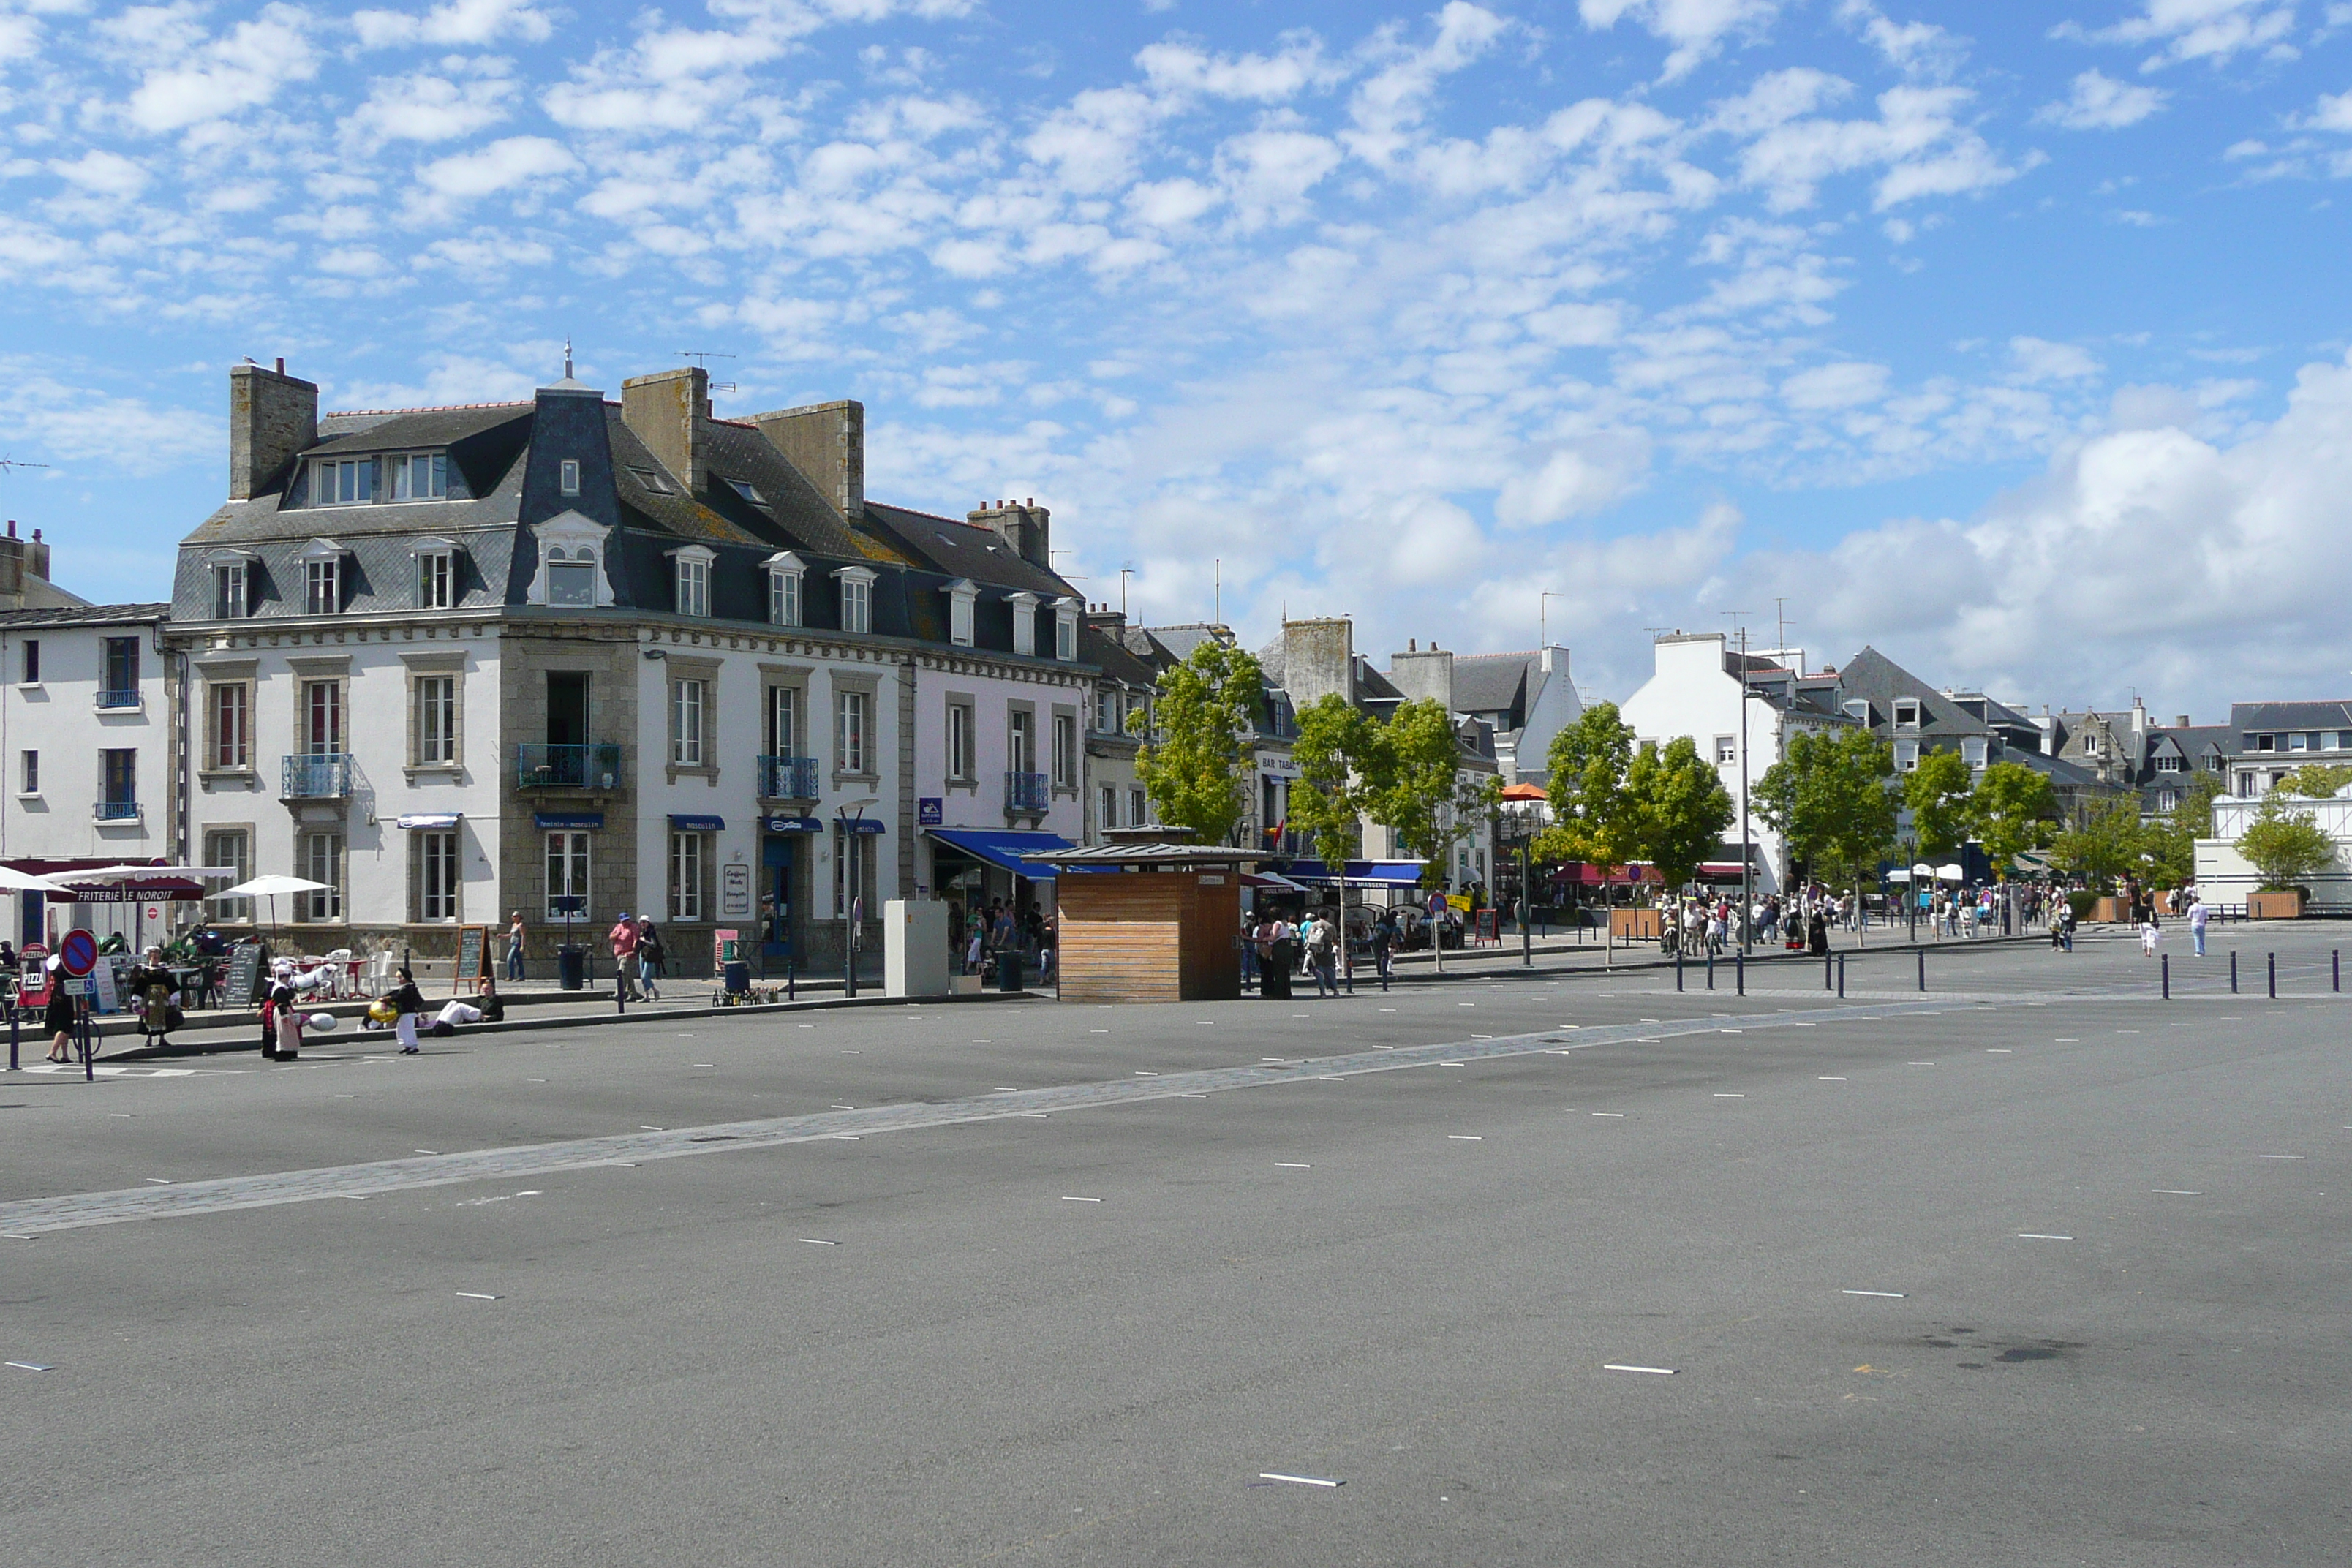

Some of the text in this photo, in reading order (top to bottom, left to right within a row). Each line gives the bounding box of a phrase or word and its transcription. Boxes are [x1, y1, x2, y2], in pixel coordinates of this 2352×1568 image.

[1262, 758, 1275, 769] BAR
[78, 890, 173, 901] FRITERIE LE NOROIT
[21, 951, 48, 959] PIZZERIA
[23, 973, 44, 984] PIZZA
